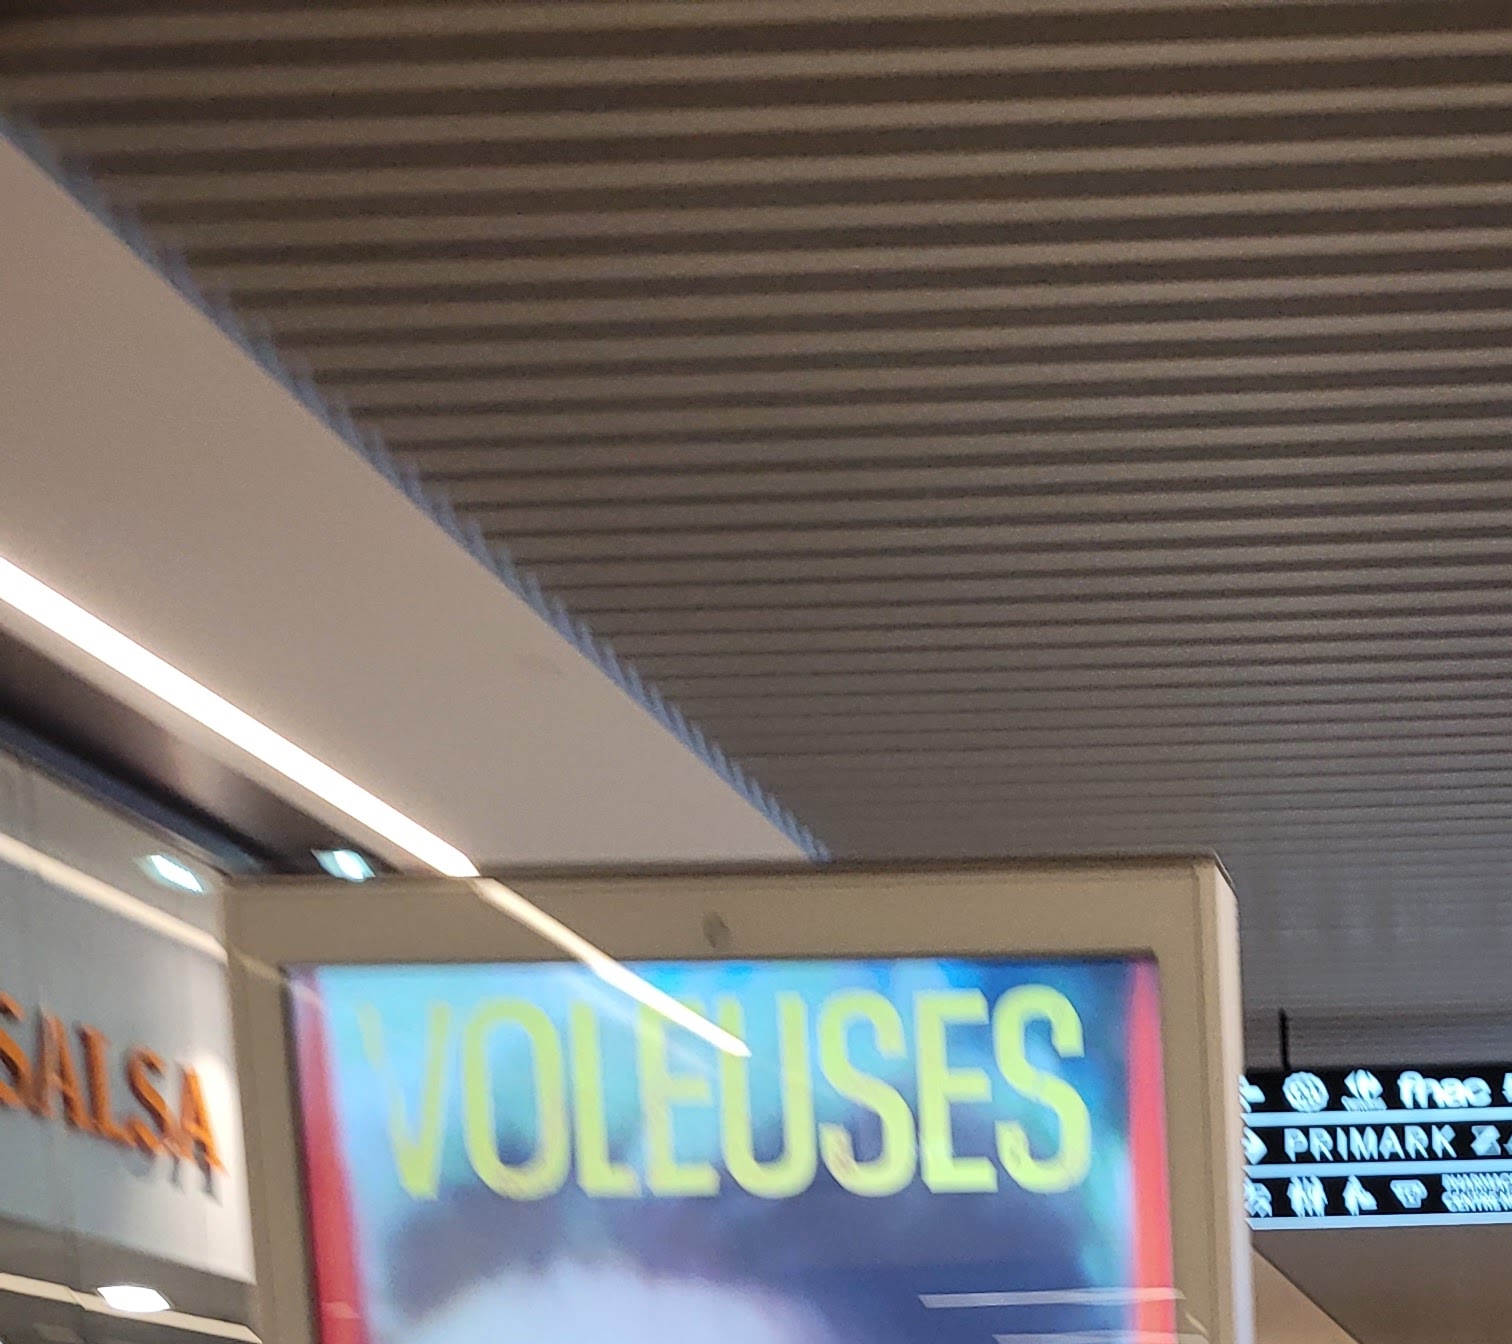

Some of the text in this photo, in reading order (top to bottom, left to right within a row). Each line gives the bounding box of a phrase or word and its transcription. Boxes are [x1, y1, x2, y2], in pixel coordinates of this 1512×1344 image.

[358, 984, 1093, 1201] VOLEUSES
[1397, 1070, 1493, 1109] fnac
[1284, 1124, 1457, 1162] PRIMARK
